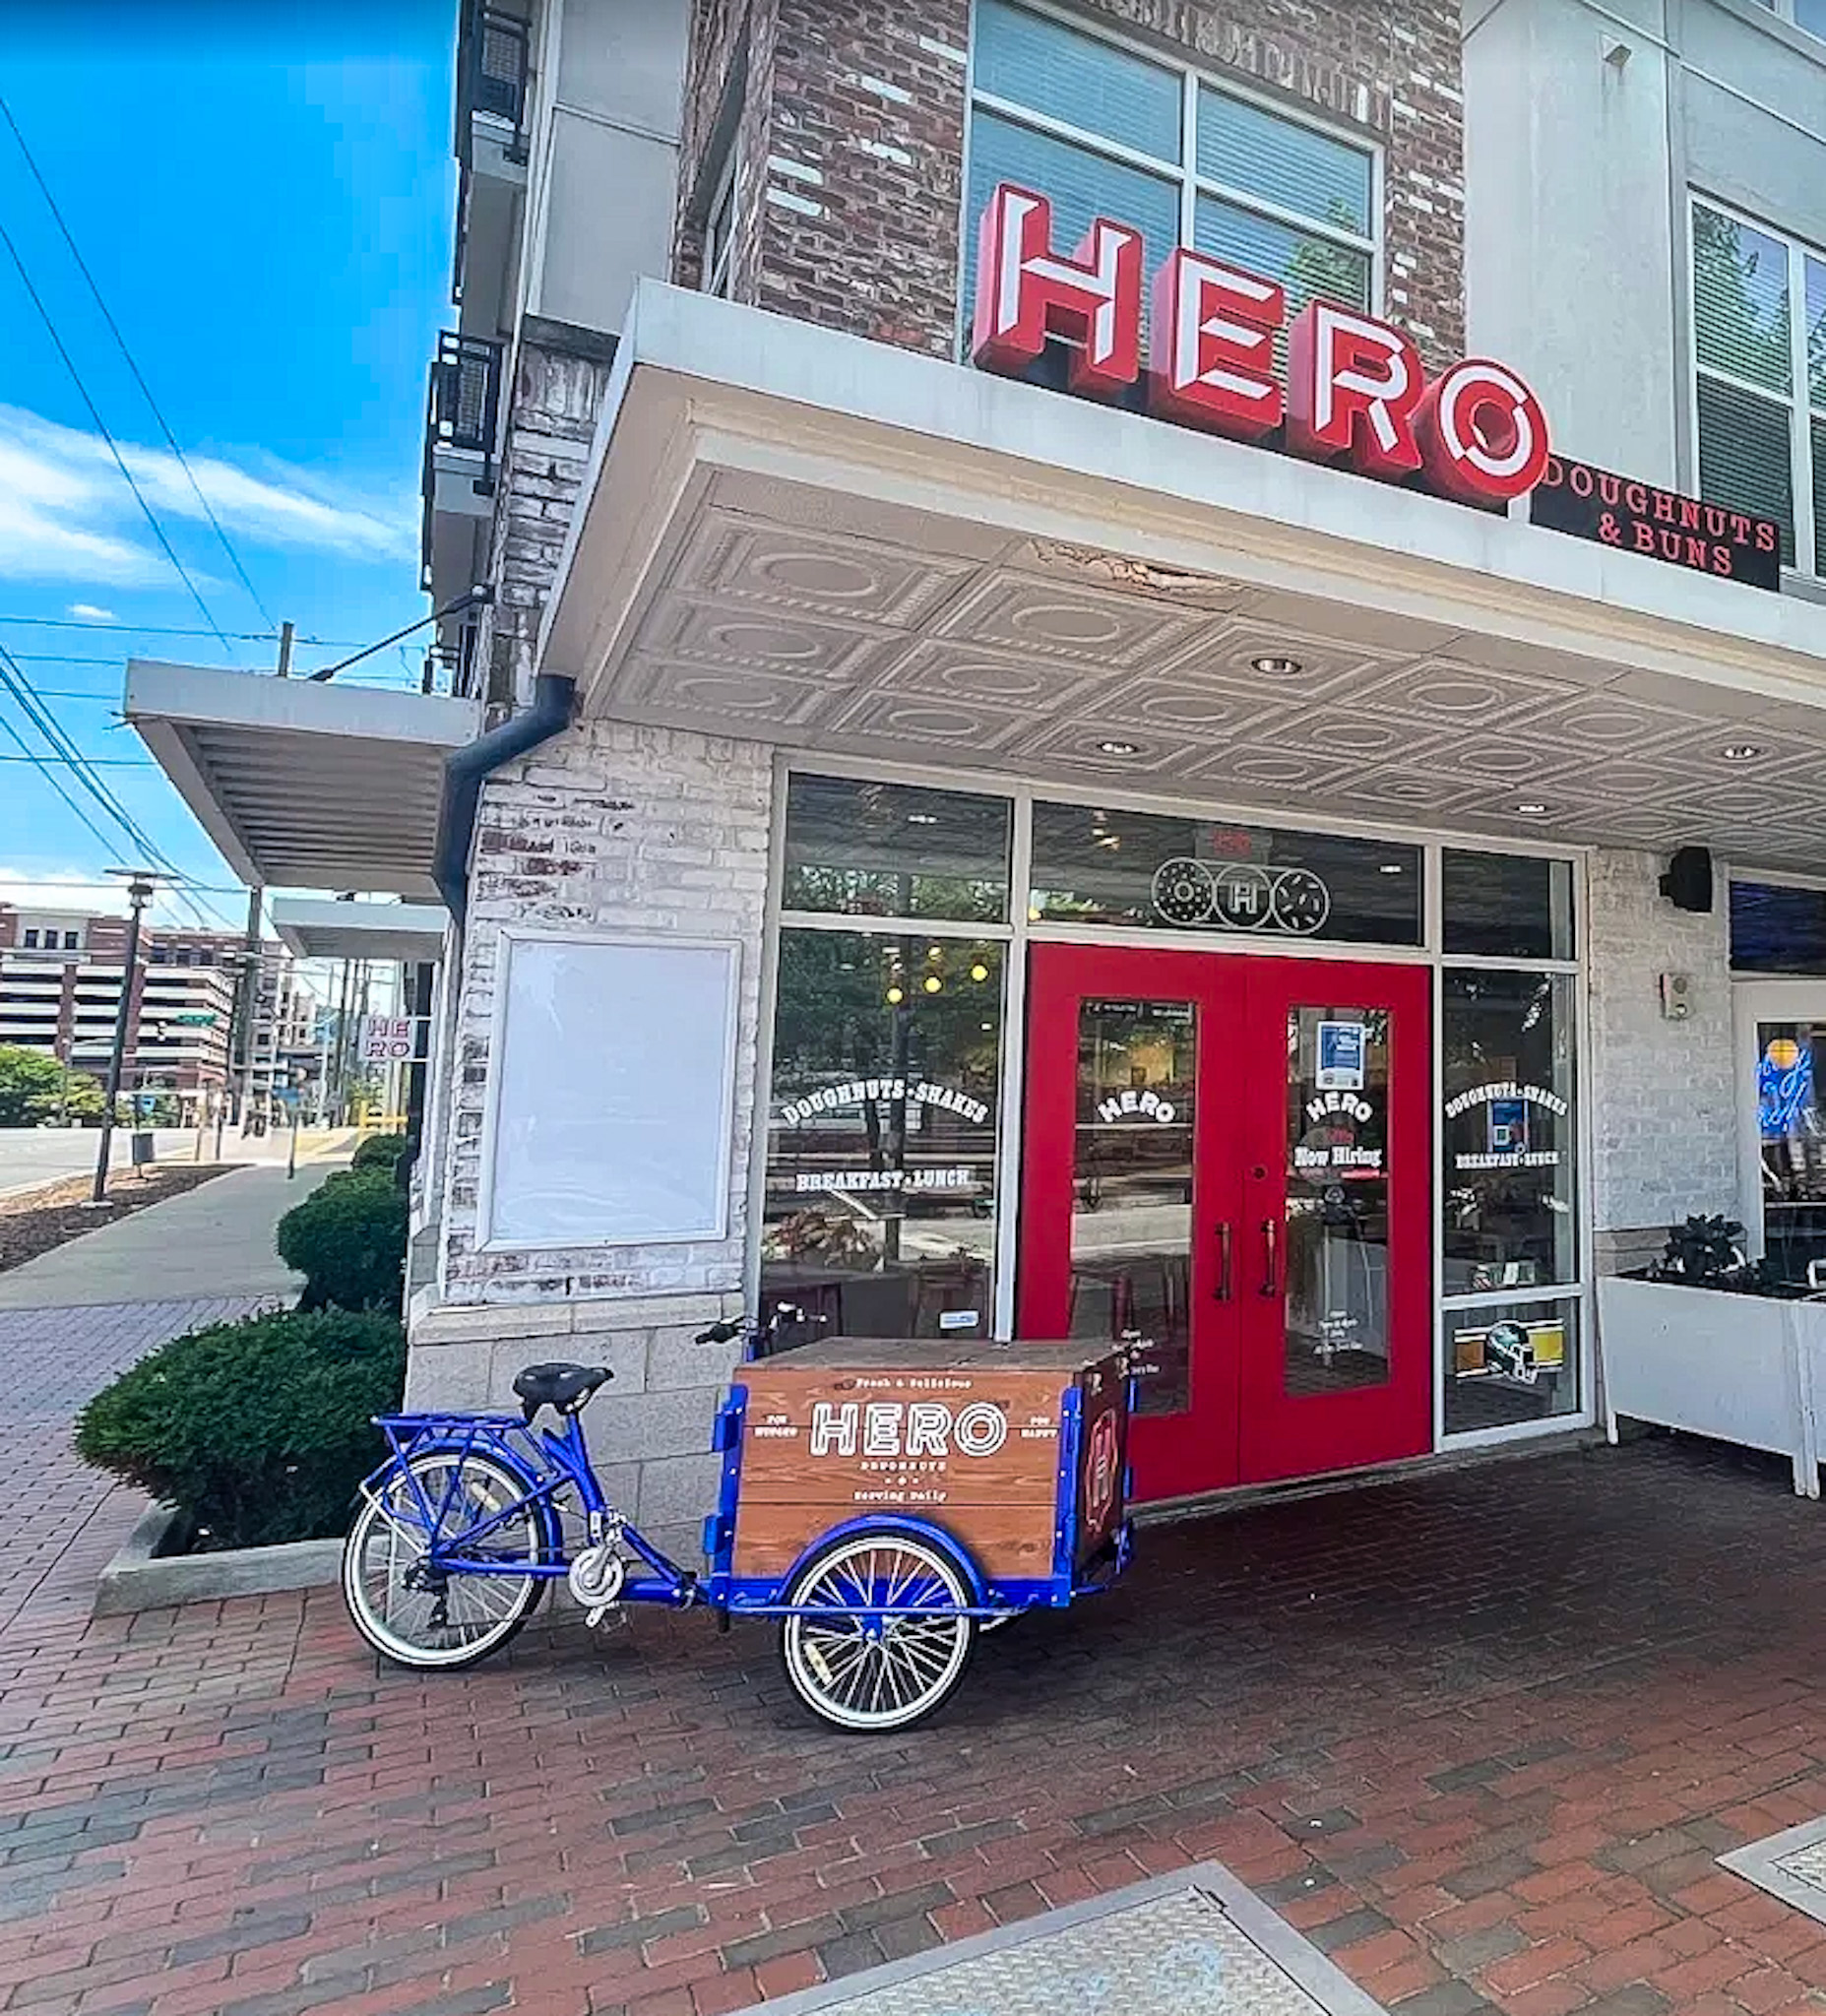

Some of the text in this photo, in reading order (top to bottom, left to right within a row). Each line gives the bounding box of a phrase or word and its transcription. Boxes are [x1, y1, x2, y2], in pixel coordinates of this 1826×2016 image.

[974, 181, 1552, 504] HERO
[1543, 457, 1776, 552] DOUGHNUTS
[1598, 511, 1733, 575] & BUNS
[781, 1078, 989, 1125] DOUGHNUTS SHAKES
[1097, 1090, 1176, 1123] HERO
[1305, 1090, 1373, 1123] HERO
[795, 1168, 971, 1192] BREAKFAST LUNCH
[1293, 1146, 1383, 1168] Now Hiring
[809, 1400, 1008, 1458] HERO
